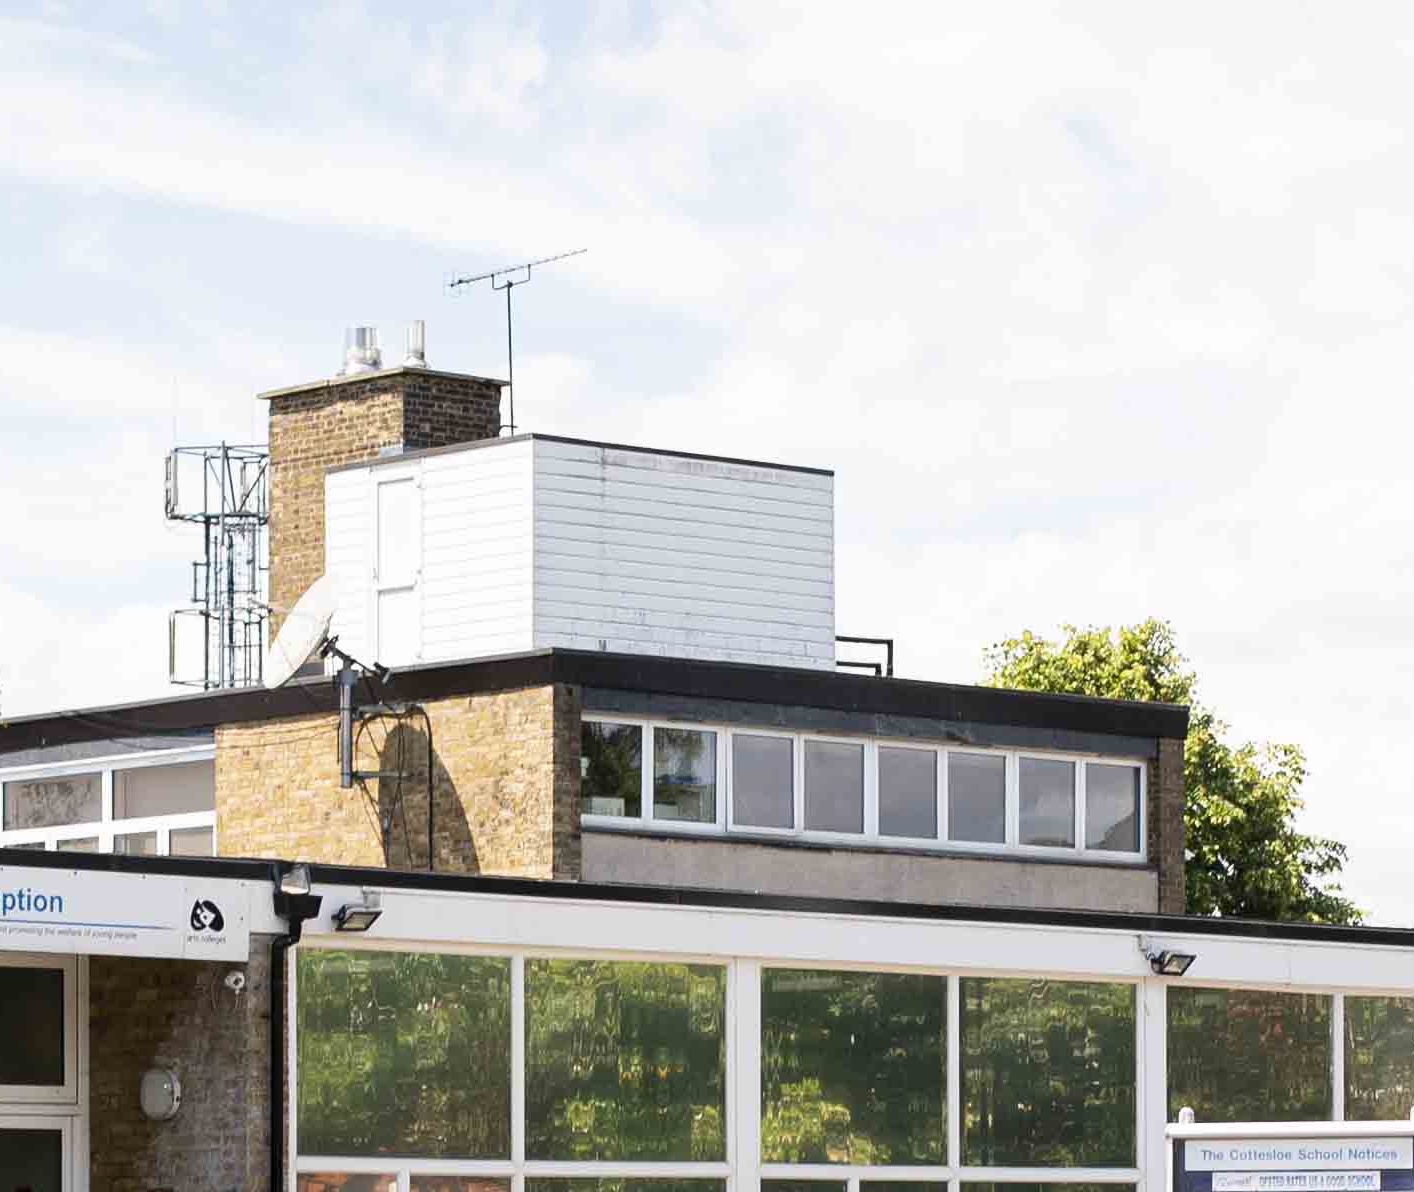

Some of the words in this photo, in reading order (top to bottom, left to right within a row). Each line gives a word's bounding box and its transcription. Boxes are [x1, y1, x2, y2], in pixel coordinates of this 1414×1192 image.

[1200, 1149, 1224, 1160] The
[1298, 1148, 1343, 1160] School
[1348, 1148, 1398, 1160] Notices
